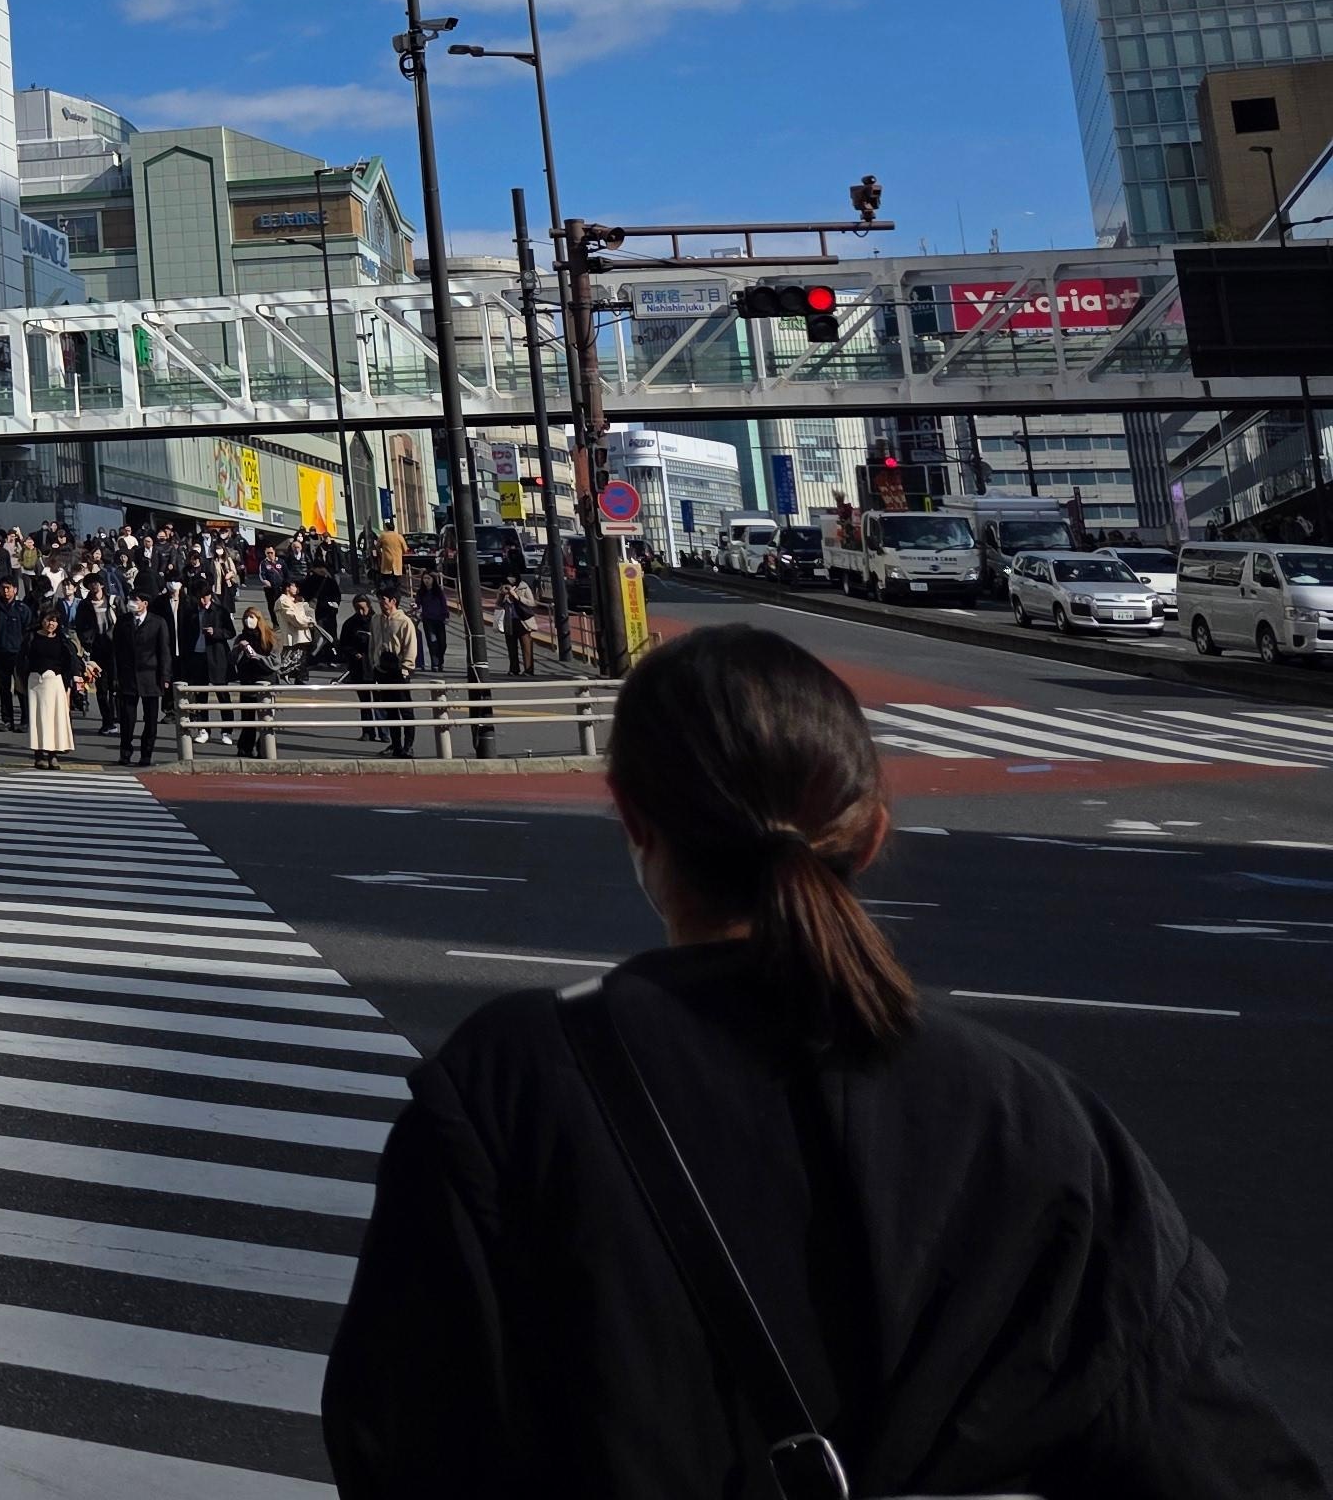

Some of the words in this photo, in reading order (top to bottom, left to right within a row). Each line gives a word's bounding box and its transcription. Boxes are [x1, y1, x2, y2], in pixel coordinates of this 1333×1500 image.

[640, 288, 721, 304] 西新宿一丁目
[964, 288, 1102, 316] Vtoria
[646, 303, 705, 313] Nishishinjuku
[707, 303, 713, 312] 1
